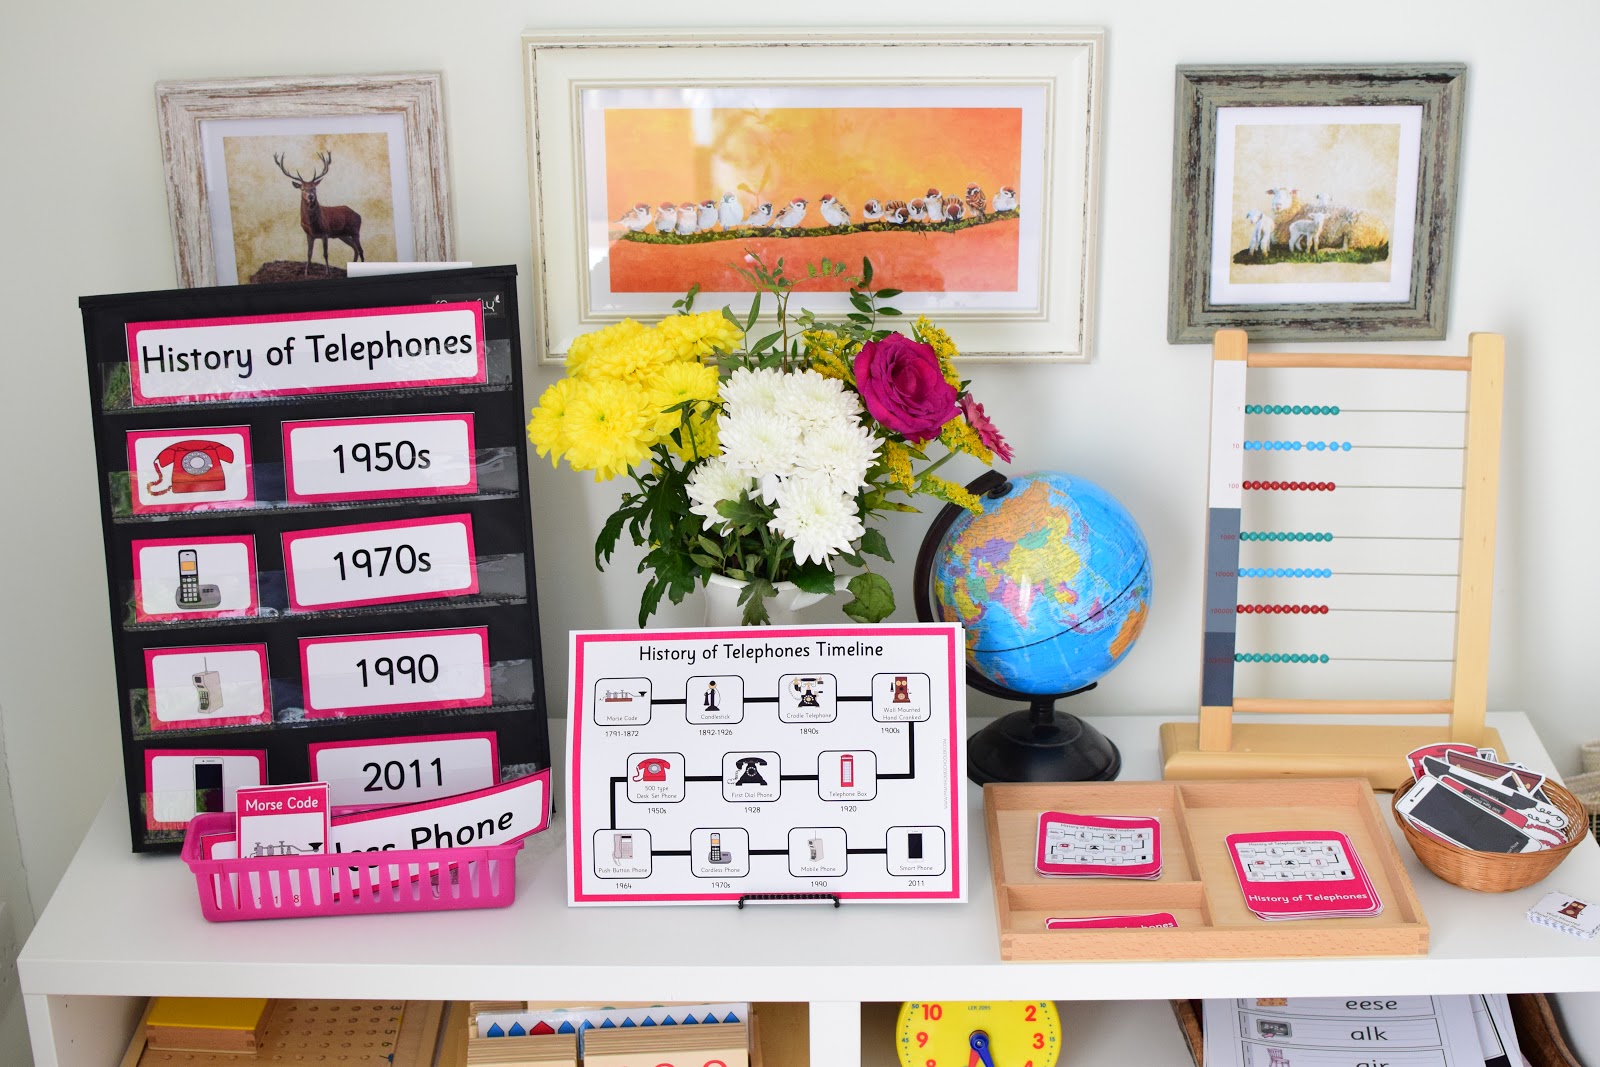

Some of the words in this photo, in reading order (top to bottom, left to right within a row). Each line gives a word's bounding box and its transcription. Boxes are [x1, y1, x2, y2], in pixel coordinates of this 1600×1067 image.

[143, 343, 252, 378] History
[266, 337, 298, 366] of
[306, 330, 473, 370] Telephones
[333, 440, 431, 474] 1950s
[333, 544, 431, 581] 1970s
[639, 645, 696, 665] History
[702, 644, 718, 660] of
[723, 642, 810, 663] Telephones
[816, 641, 884, 657] Timeline
[356, 653, 440, 688] 1990
[362, 758, 444, 792] 2011
[246, 799, 283, 812] Morse
[287, 796, 319, 809] Code
[411, 811, 514, 850] Phone
[1248, 894, 1290, 904] History
[1305, 893, 1368, 903] Telephones
[922, 1004, 942, 1021] 10
[1024, 1005, 1037, 1022] 2
[1345, 1000, 1398, 1010] eese
[916, 1031, 928, 1048] 9
[1032, 1033, 1045, 1049] 3
[1351, 1026, 1388, 1041] alk
